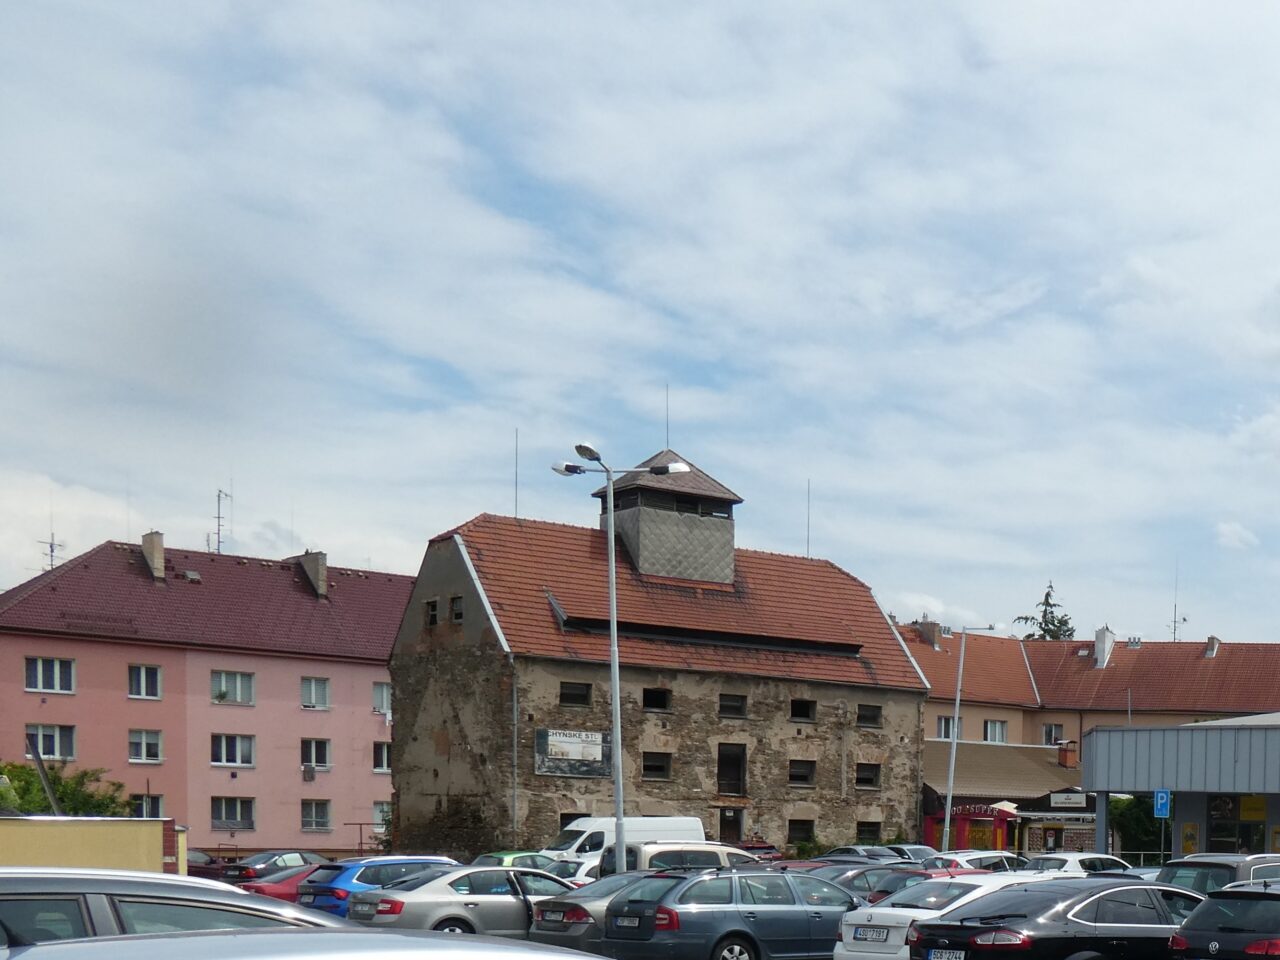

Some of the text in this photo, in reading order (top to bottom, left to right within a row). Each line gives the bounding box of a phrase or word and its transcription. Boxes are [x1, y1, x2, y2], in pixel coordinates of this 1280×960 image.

[1157, 792, 1167, 809] P
[970, 804, 999, 816] SUPER
[946, 950, 962, 960] 2744
